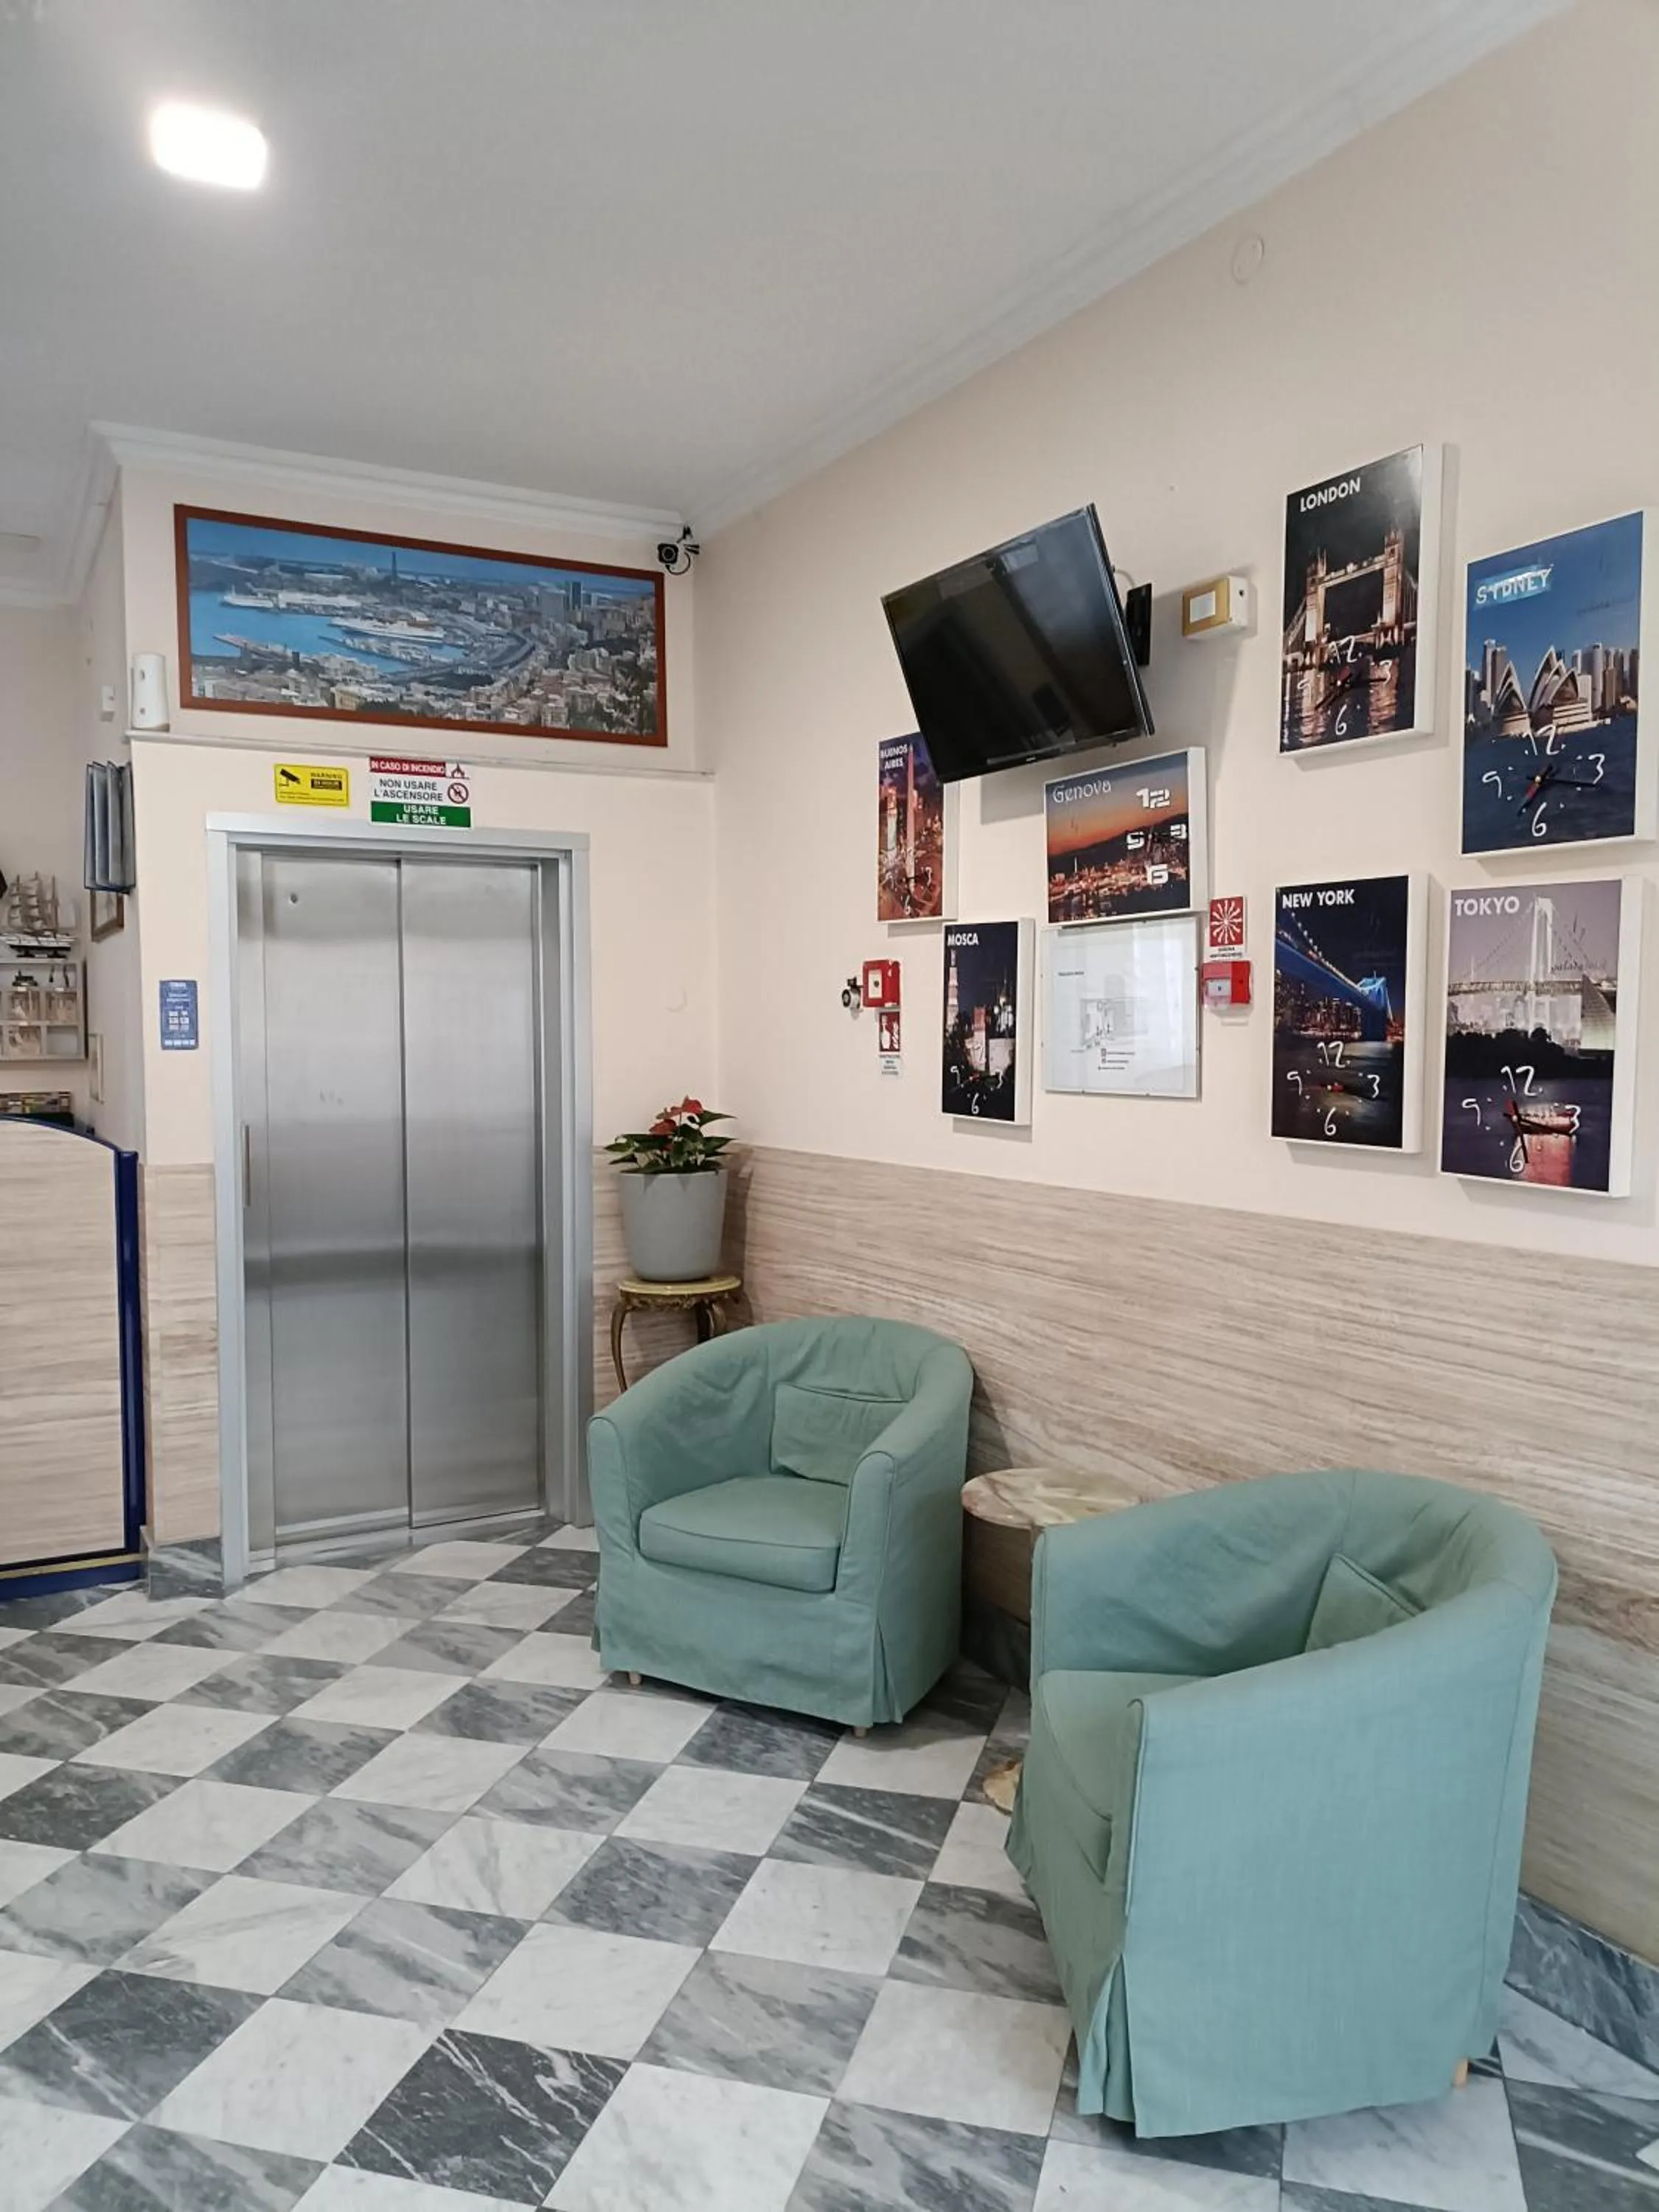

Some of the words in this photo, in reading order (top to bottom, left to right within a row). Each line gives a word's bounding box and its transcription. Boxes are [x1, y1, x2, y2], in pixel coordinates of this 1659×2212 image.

[1299, 477, 1361, 513] LONDON
[1475, 566, 1553, 605] SYDNEY
[1335, 703, 1348, 736] 6
[880, 743, 908, 758] BUENOS
[1523, 723, 1561, 757] 12
[371, 761, 379, 769] IN
[380, 761, 400, 771] CASO
[402, 764, 409, 772] DI
[411, 764, 445, 774] INCENDIO
[885, 757, 904, 769] AIRES
[1588, 753, 1605, 785] 3
[374, 788, 443, 801] L'ASCENSORE
[380, 779, 402, 788] NON
[403, 780, 437, 790] USARE
[1052, 779, 1112, 804] Genova
[1481, 771, 1503, 799] 9
[403, 804, 439, 815] USARE
[1136, 787, 1171, 809] 12
[396, 813, 410, 823] LE
[412, 815, 446, 825] SCALE
[1531, 801, 1548, 838] 6
[1170, 824, 1187, 839] 3
[1147, 863, 1169, 885] 6
[1281, 892, 1313, 909] NEW
[1316, 889, 1355, 906] YORK
[1455, 896, 1520, 917] TOKYO
[947, 933, 979, 947] MOSCA
[1317, 1040, 1346, 1068] 12
[1287, 1071, 1302, 1096] 9
[1367, 1074, 1380, 1098] 3
[1501, 1065, 1537, 1097] 12
[971, 1092, 980, 1115] 6
[1462, 1099, 1481, 1127] 9
[1324, 1107, 1337, 1136] 6
[1564, 1106, 1582, 1134] 3
[1509, 1138, 1526, 1173] 6
